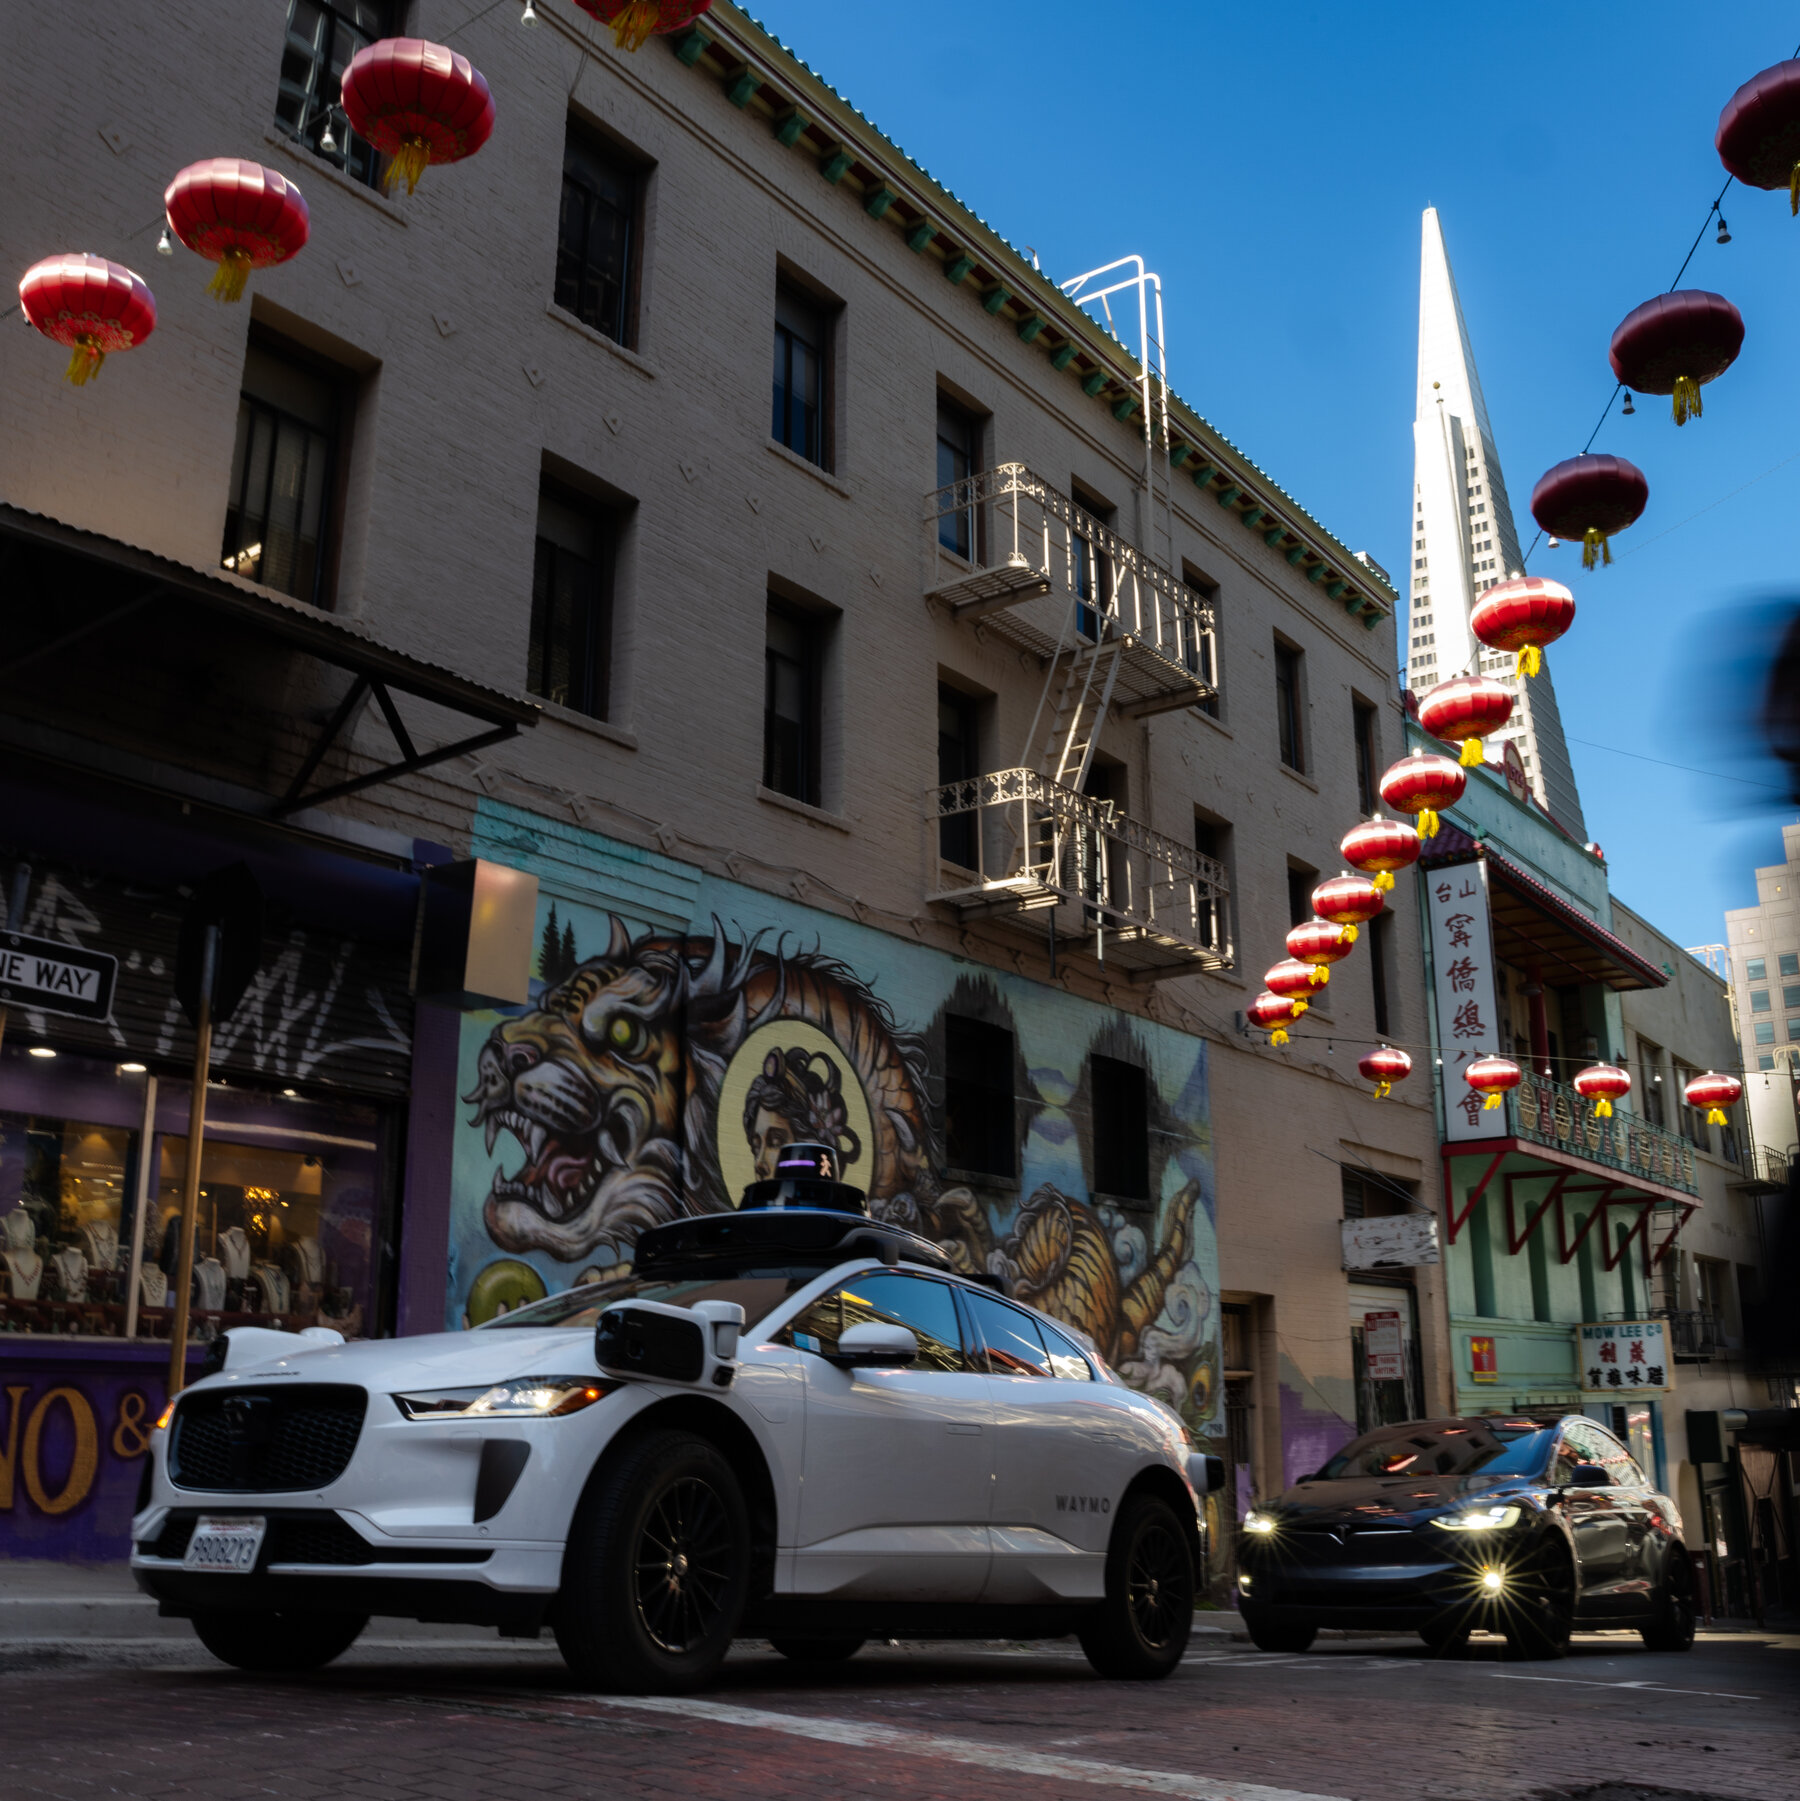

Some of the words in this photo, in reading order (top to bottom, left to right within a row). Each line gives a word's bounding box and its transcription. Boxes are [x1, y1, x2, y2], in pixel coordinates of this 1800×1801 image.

[36, 960, 93, 996] WAY
[1582, 1327, 1615, 1339] MOW
[1620, 1325, 1642, 1338] LEE
[113, 1392, 158, 1458] &
[1055, 1494, 1111, 1514] WAYMO
